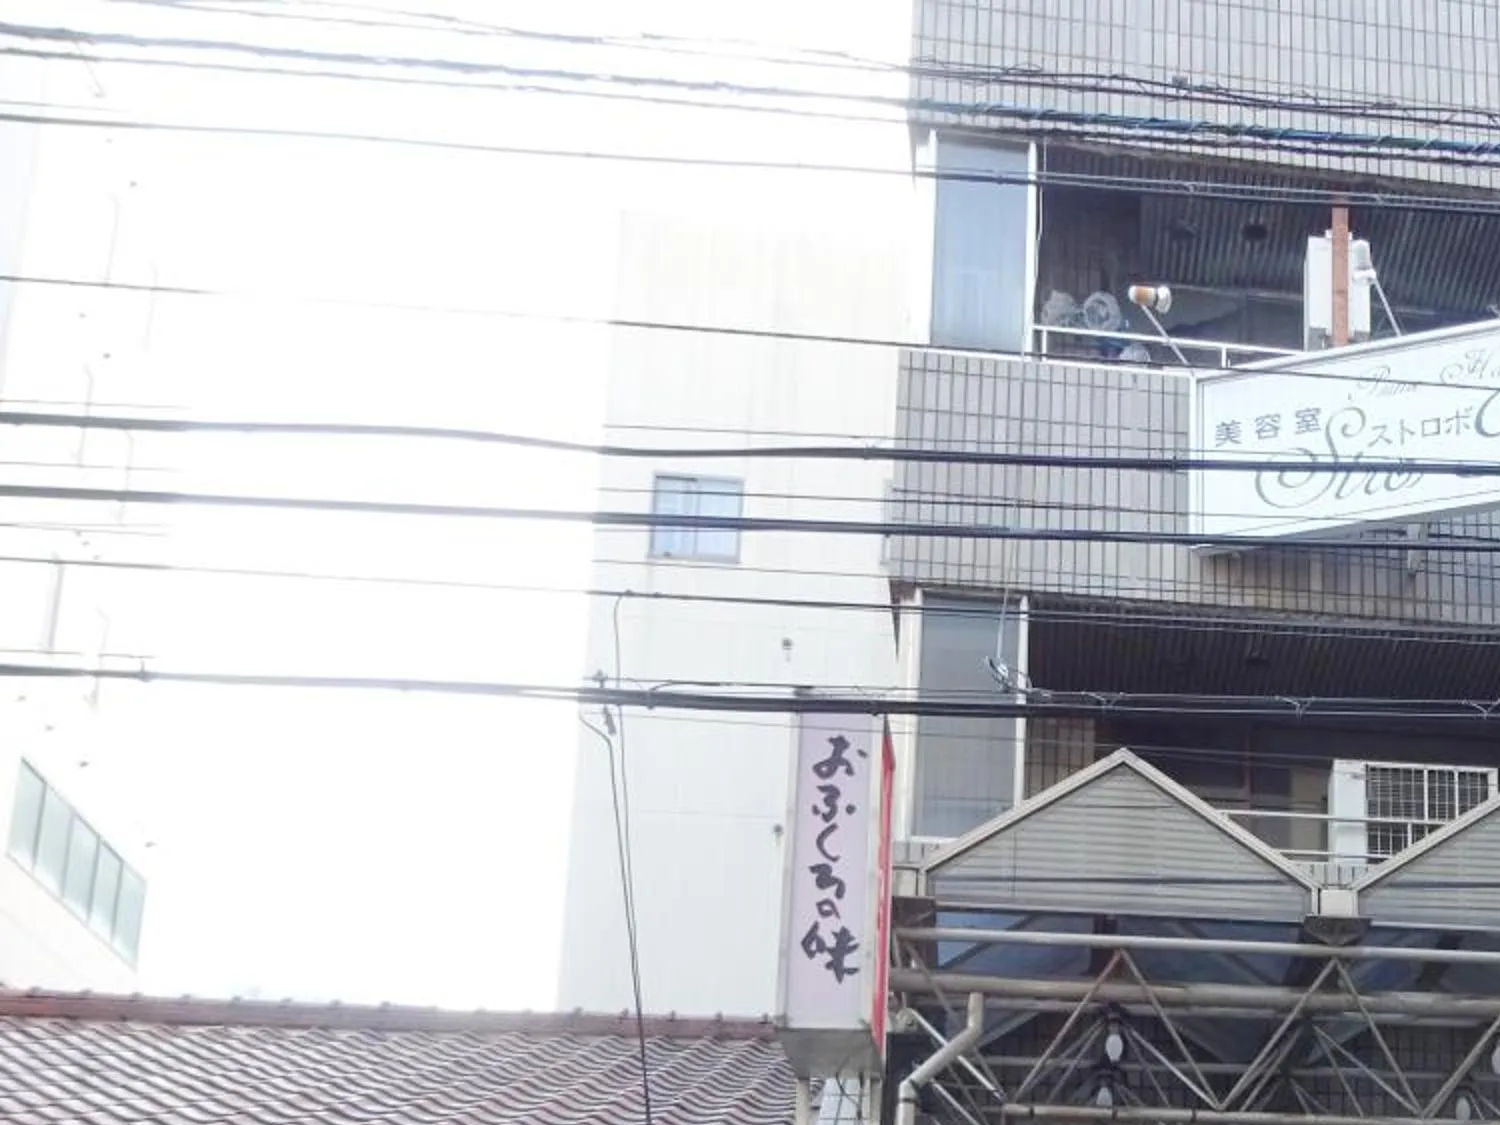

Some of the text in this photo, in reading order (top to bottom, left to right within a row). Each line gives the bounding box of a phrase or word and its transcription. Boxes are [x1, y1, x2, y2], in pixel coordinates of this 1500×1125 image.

[1214, 406, 1474, 448] 美容室 ストロボ
[801, 736, 868, 984] おふくろの味
